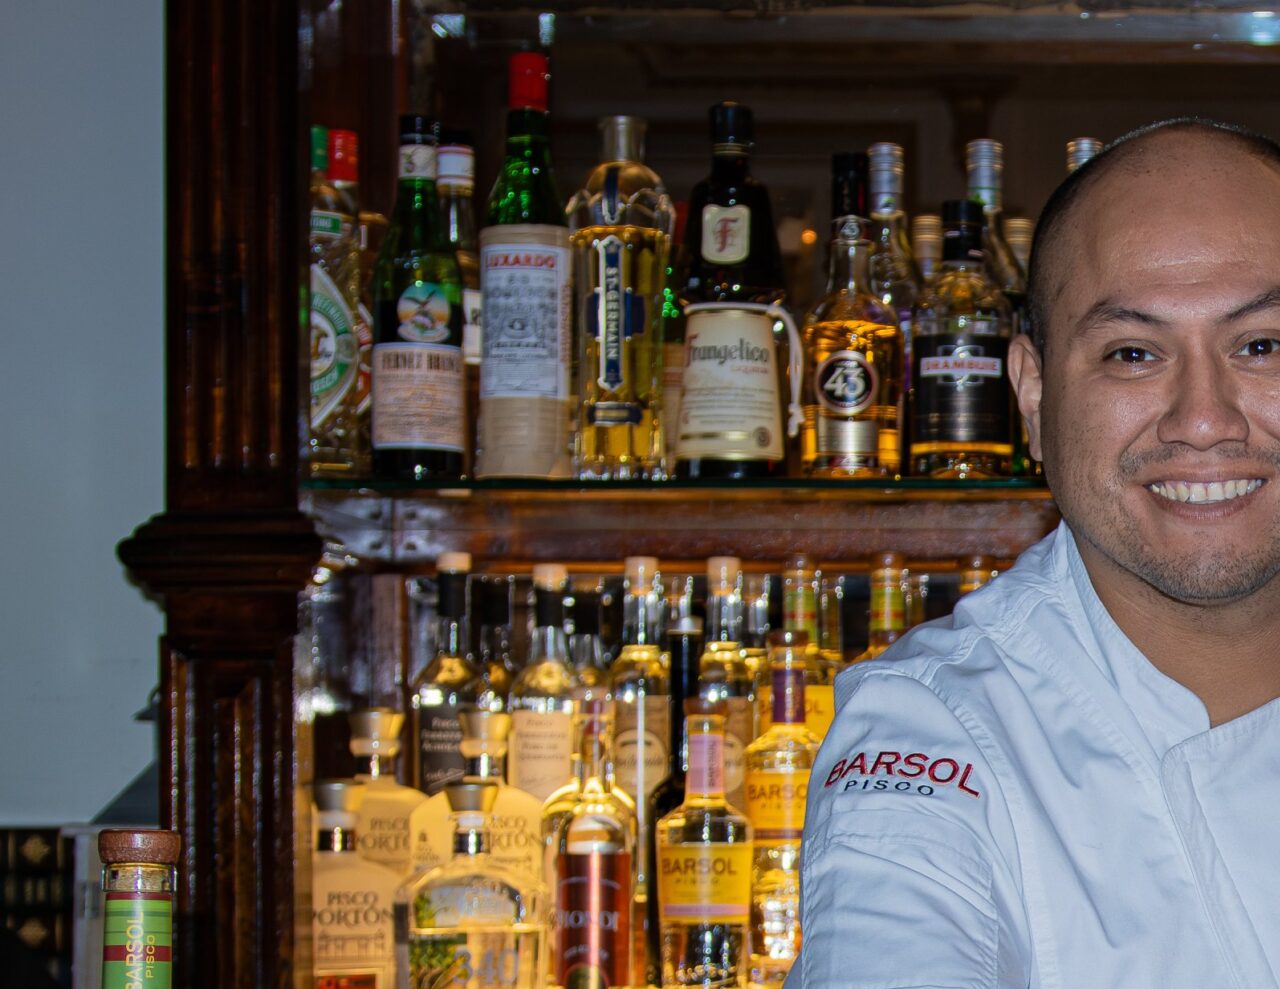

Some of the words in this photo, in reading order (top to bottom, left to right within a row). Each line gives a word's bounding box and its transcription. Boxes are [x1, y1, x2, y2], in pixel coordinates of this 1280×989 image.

[485, 252, 557, 269] LUXARDO
[684, 333, 771, 368] Frangelico
[924, 358, 998, 372] DRAMBUIE
[824, 365, 866, 399] 43
[824, 751, 981, 800] BARSOL
[750, 783, 808, 800] BARSO
[843, 779, 935, 796] PISCO
[662, 857, 737, 876] BARSOL
[145, 934, 155, 979] PISCO
